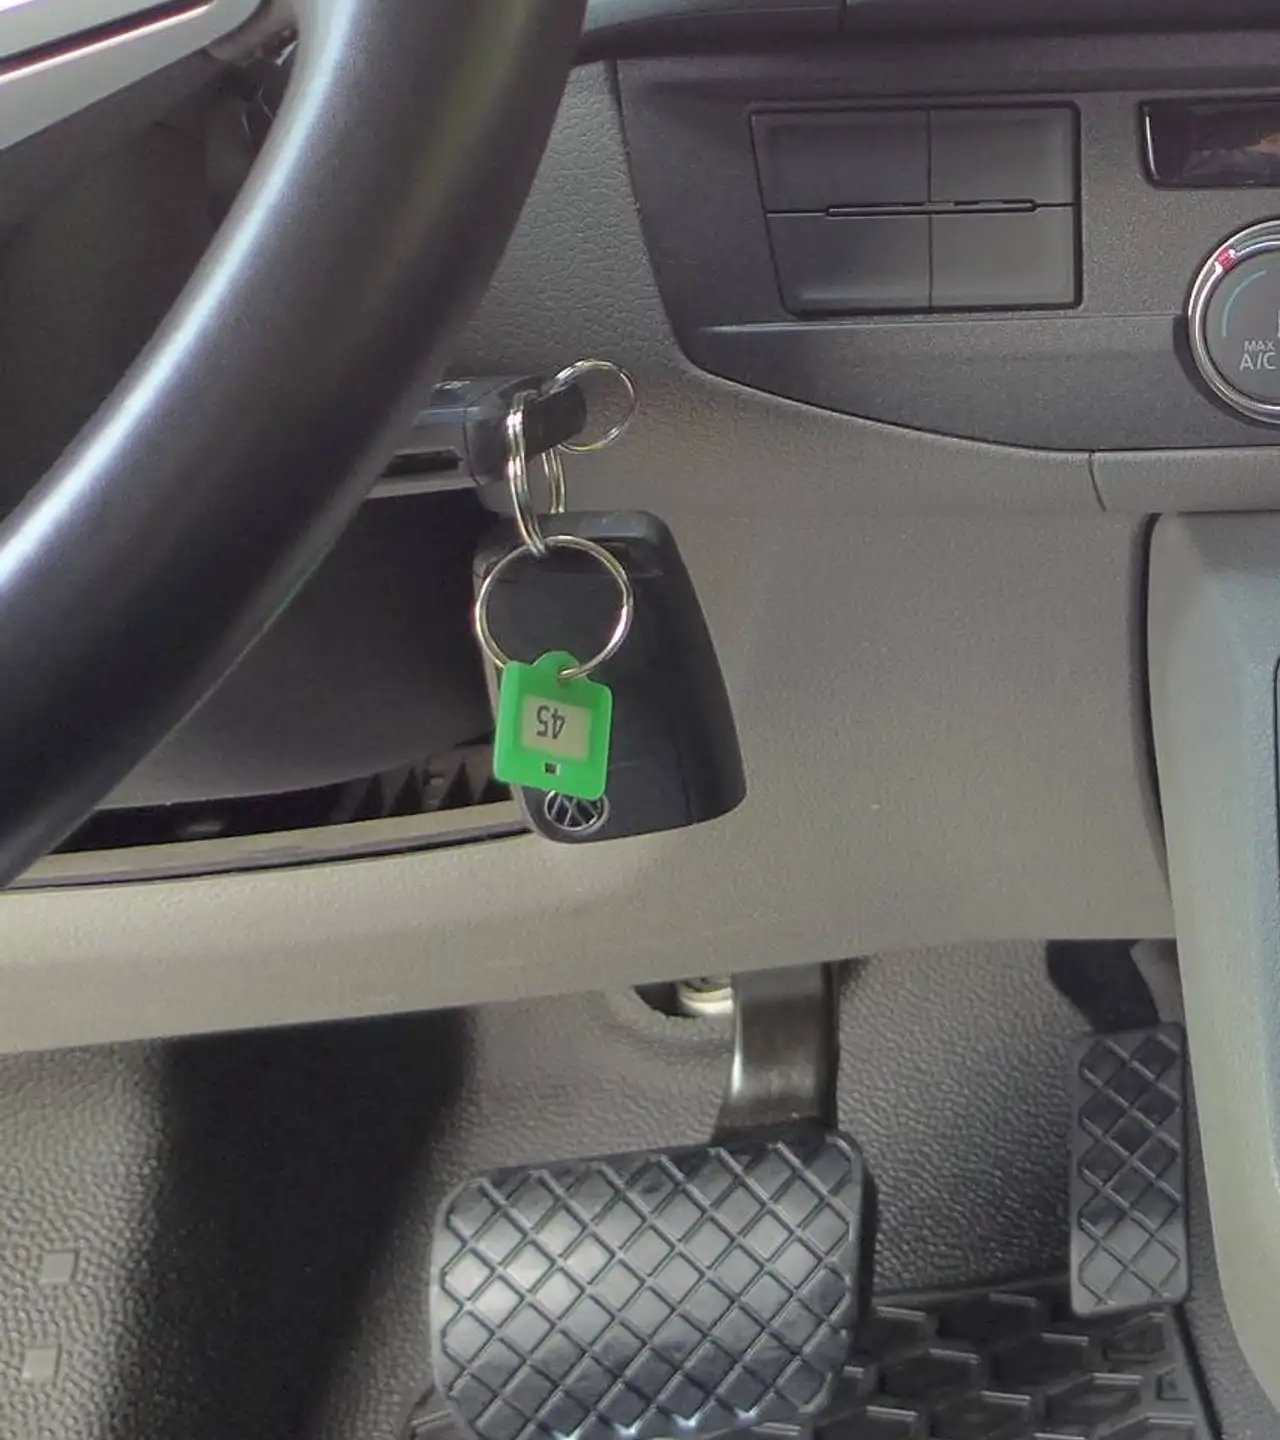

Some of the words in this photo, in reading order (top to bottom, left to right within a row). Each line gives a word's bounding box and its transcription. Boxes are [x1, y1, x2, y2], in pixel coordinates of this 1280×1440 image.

[1244, 340, 1275, 352] MAX
[1239, 351, 1277, 370] A/C
[536, 705, 565, 740] 45
